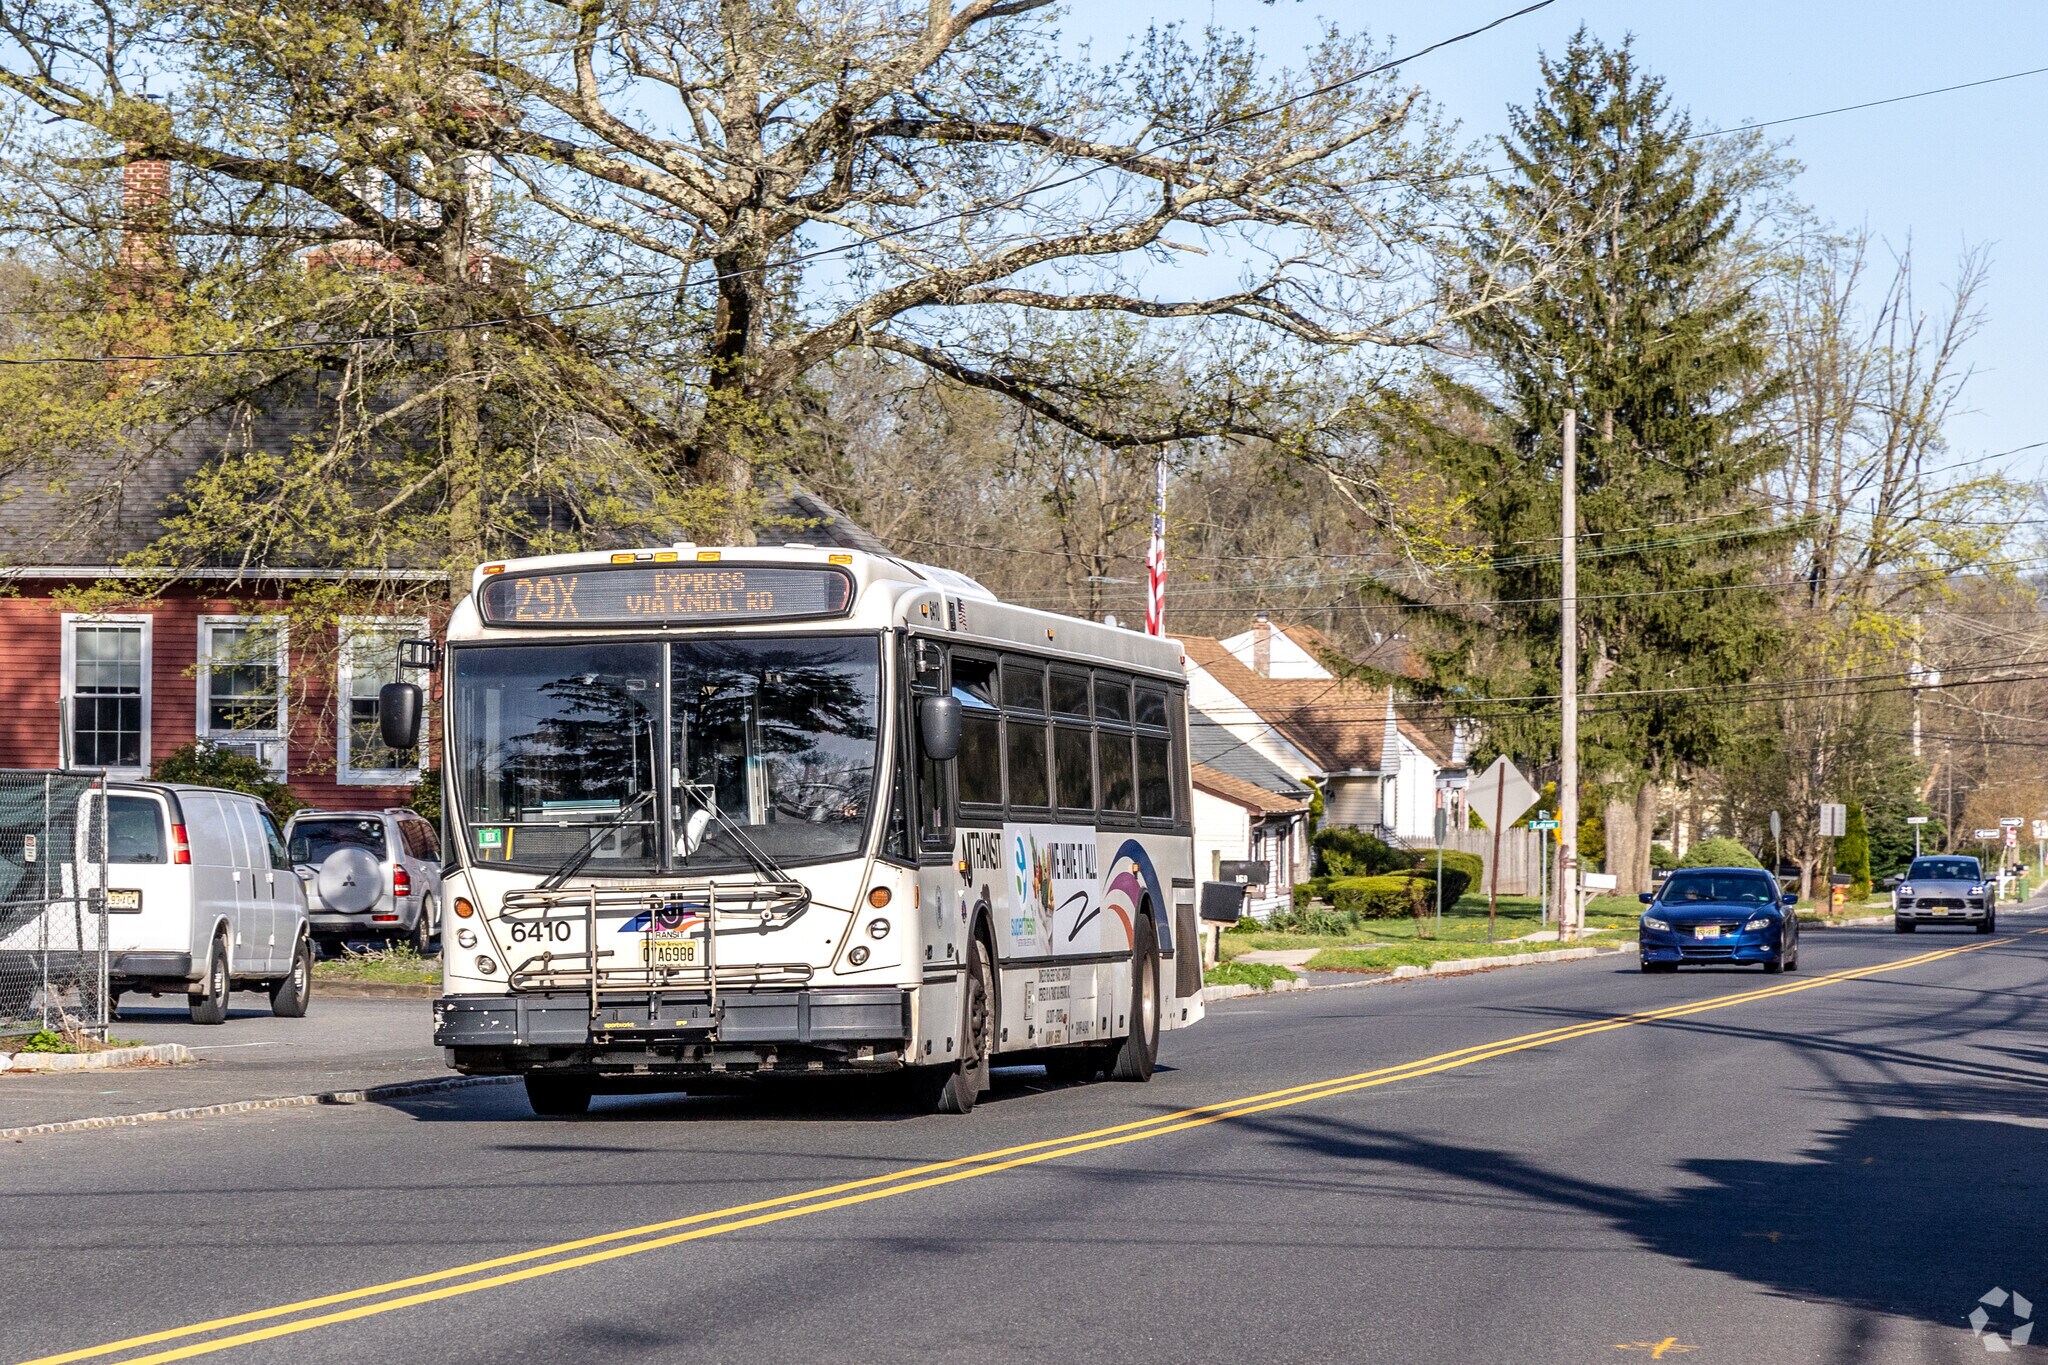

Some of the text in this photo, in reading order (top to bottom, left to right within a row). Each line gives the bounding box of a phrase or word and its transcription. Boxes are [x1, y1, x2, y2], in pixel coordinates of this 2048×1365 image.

[655, 572, 745, 593] EXPRESS
[515, 578, 579, 619] 29X
[626, 591, 773, 613] VIA KNOLL RD
[1061, 843, 1077, 879] HAVE
[511, 921, 571, 942] 6410
